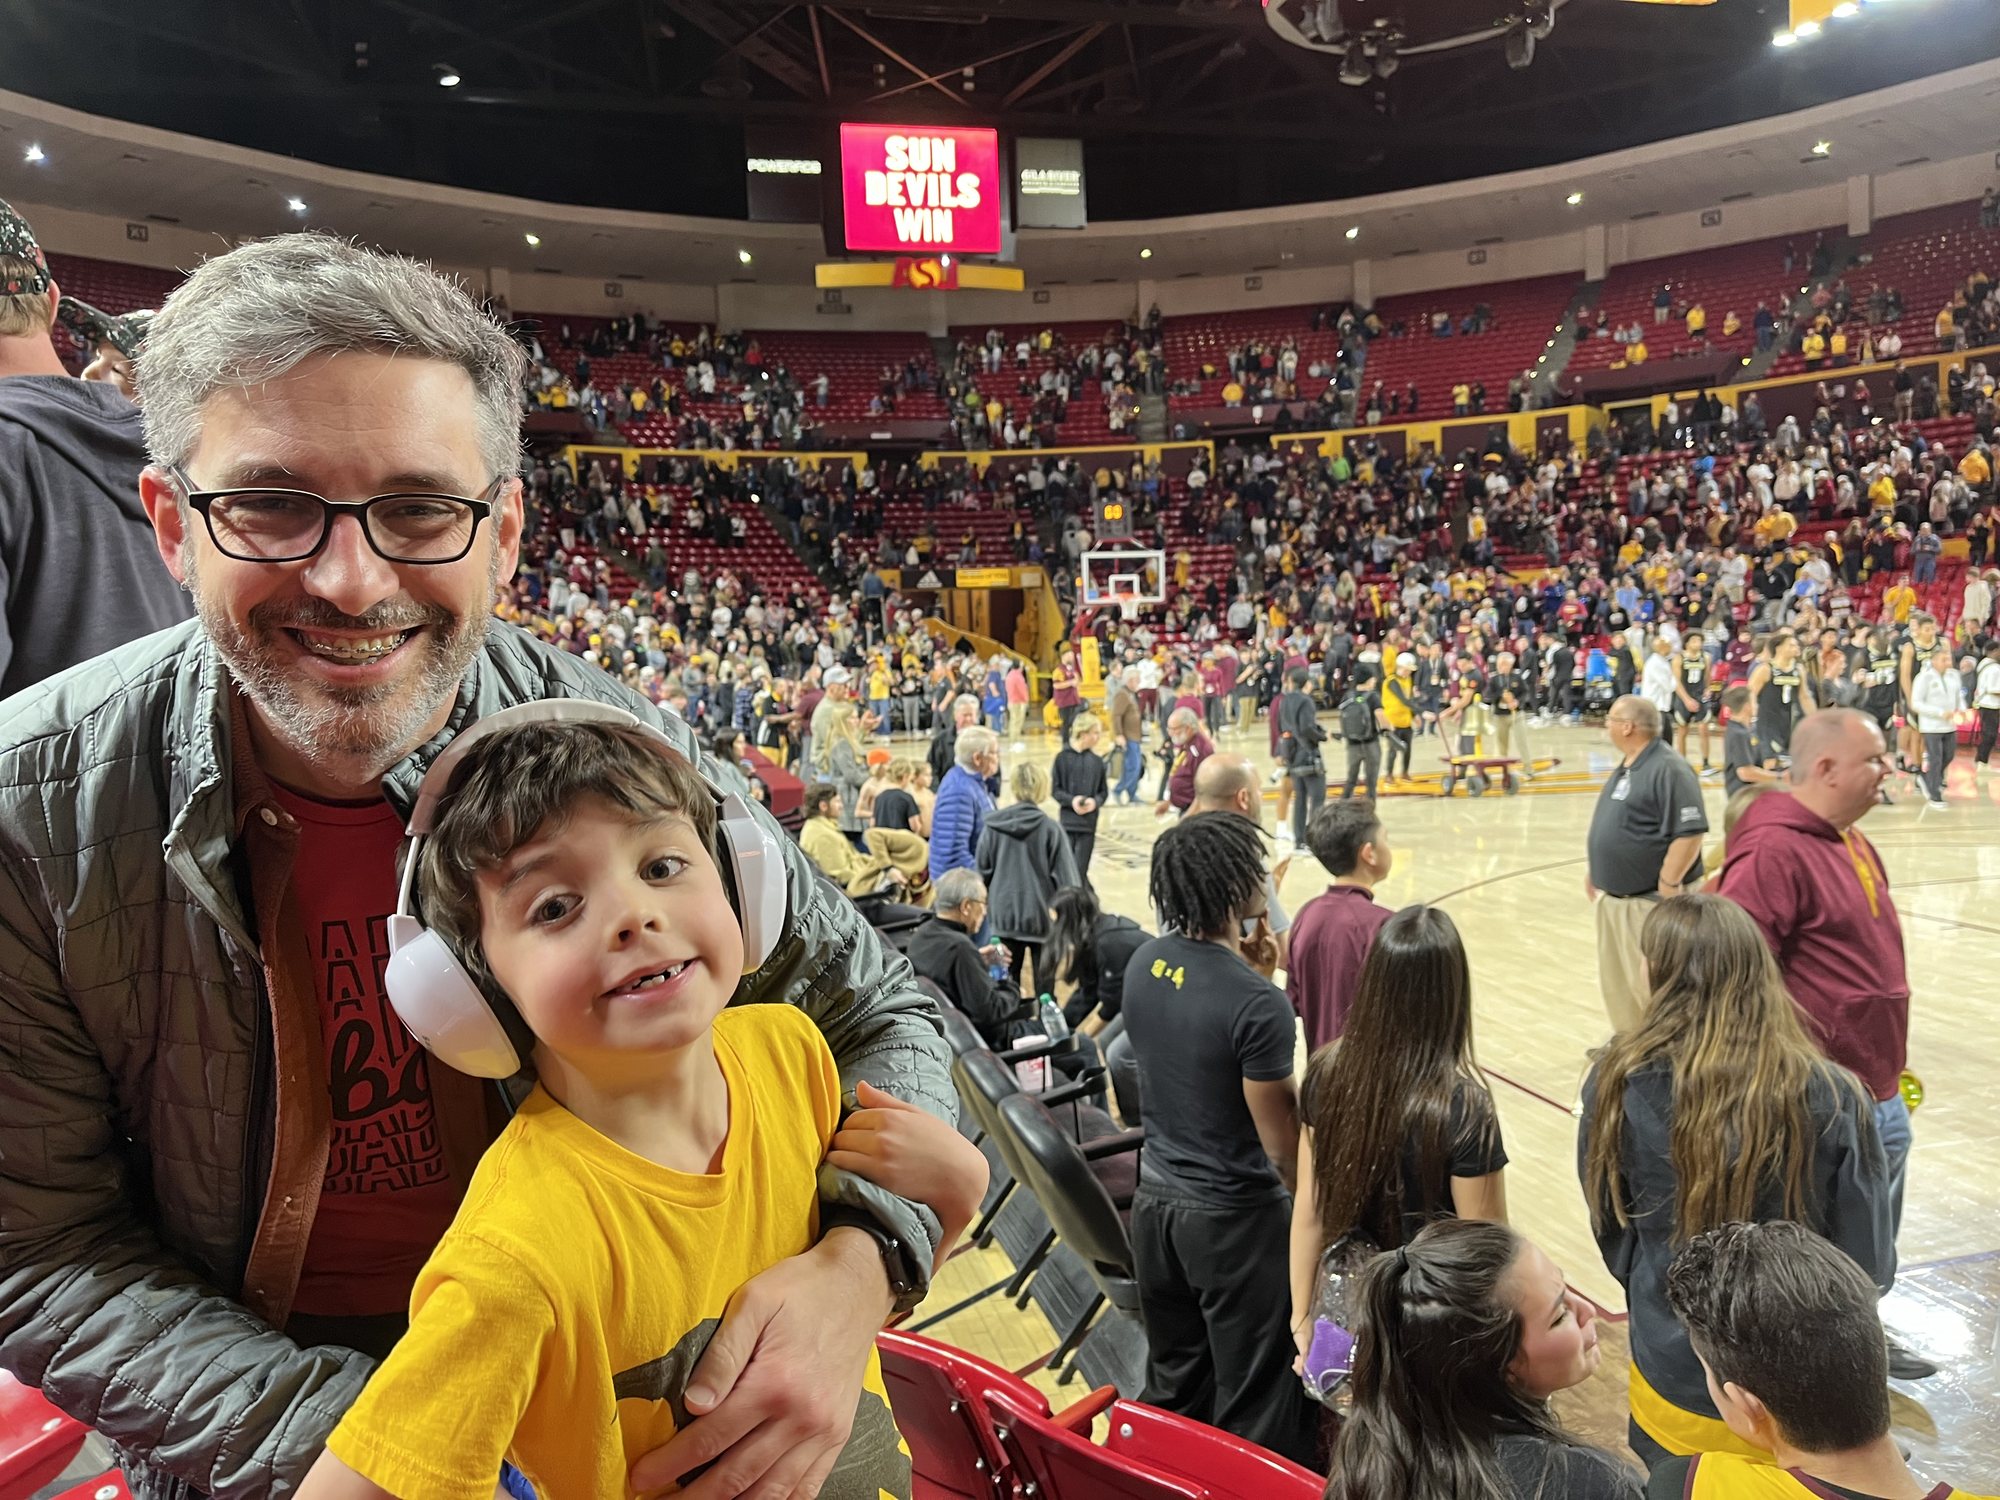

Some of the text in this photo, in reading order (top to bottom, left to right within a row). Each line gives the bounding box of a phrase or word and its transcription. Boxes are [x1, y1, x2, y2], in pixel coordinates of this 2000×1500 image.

[884, 135, 957, 173] SUN
[864, 169, 981, 209] DEVILS
[892, 207, 954, 244] WIN
